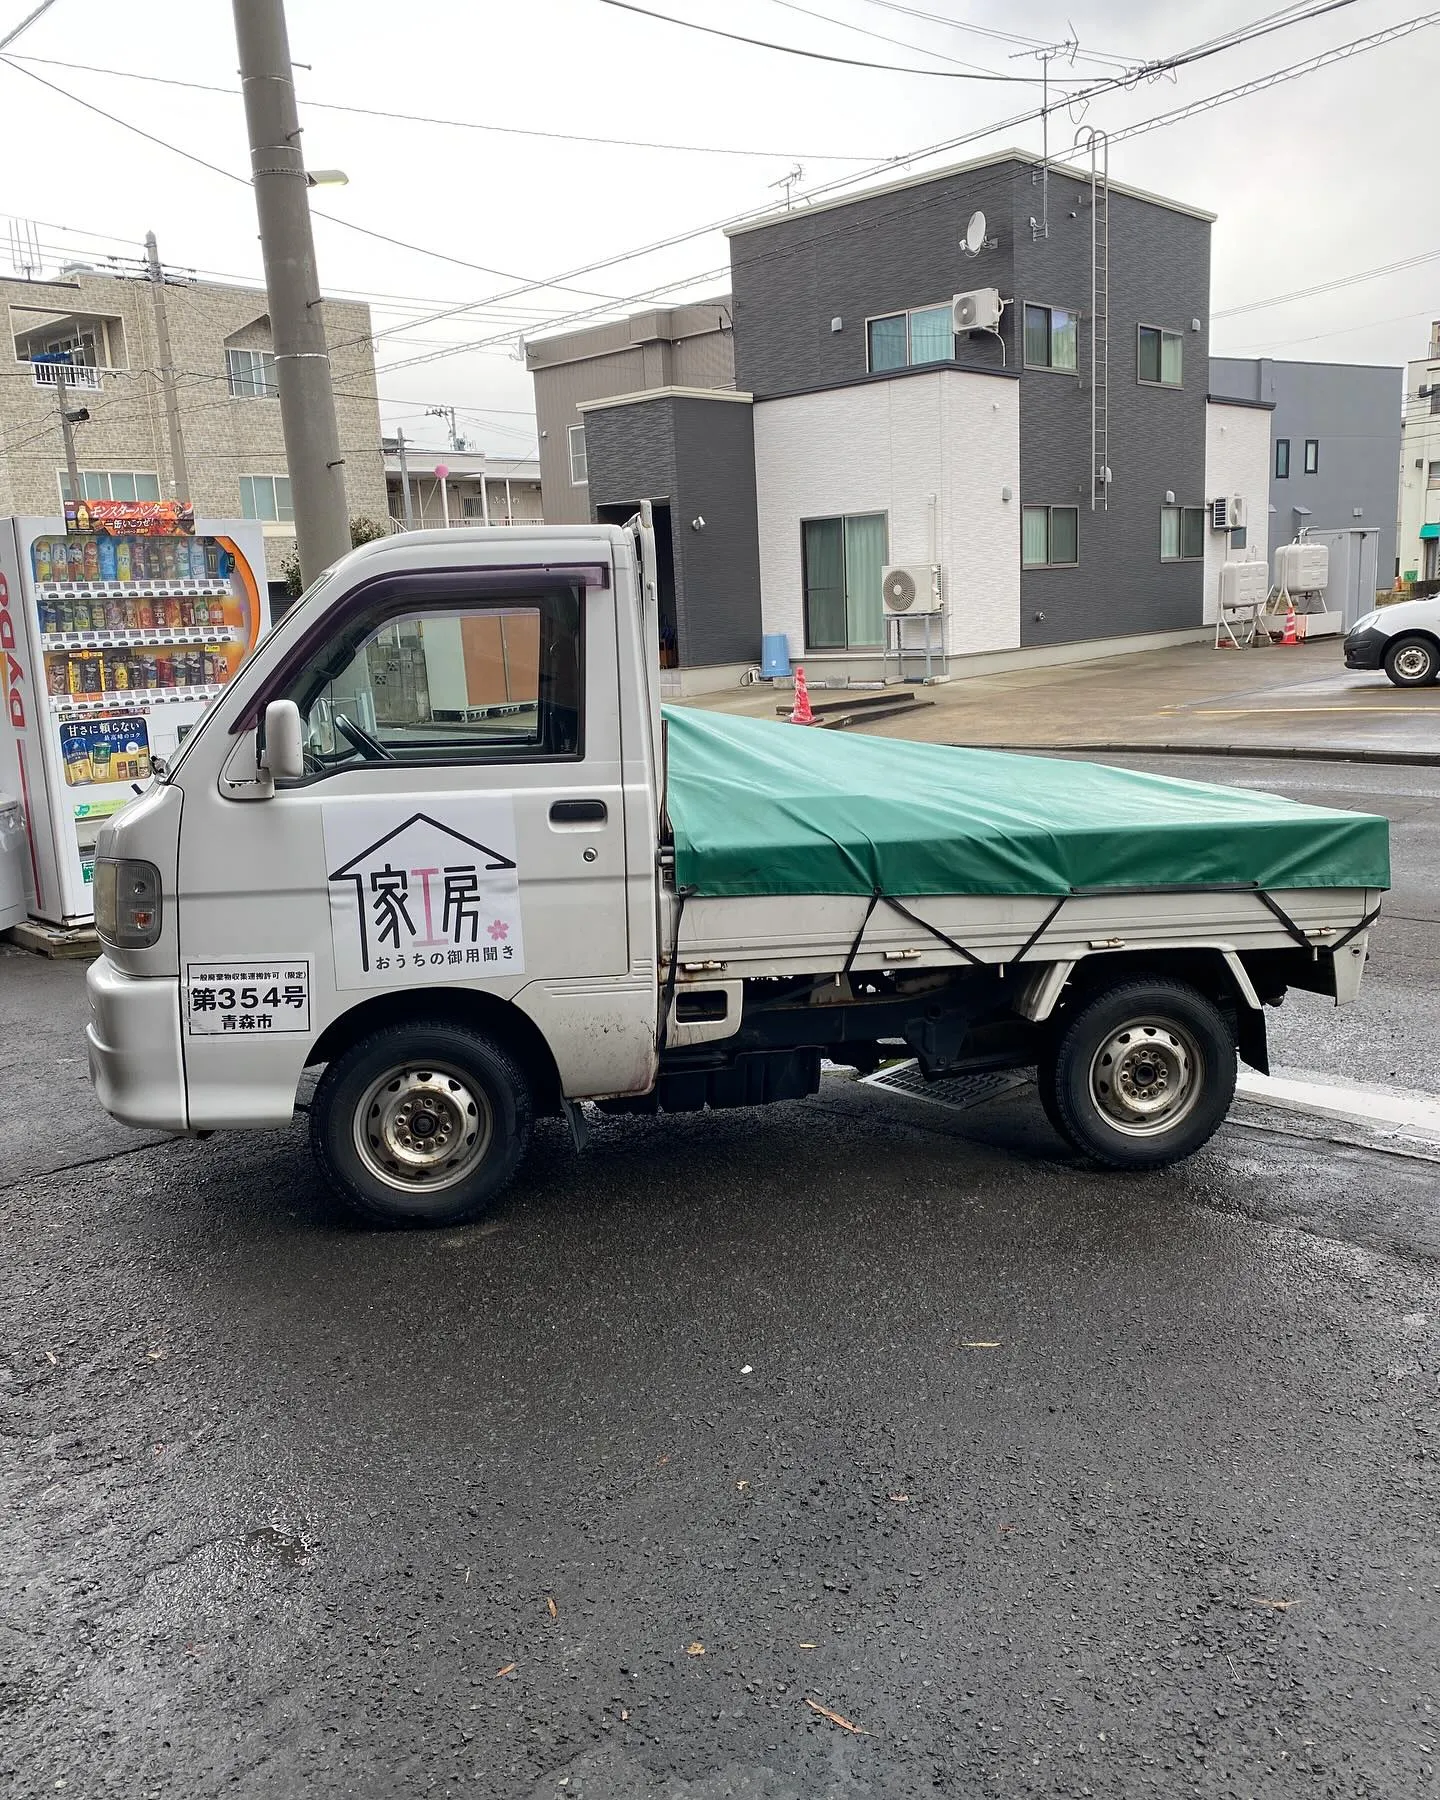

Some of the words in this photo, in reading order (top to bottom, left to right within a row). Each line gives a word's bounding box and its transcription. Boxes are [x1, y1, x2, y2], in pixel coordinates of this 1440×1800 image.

[90, 504, 168, 518] モンスターハンター
[67, 721, 140, 737] 甘さに頼らない
[370, 864, 481, 949] 家工房
[376, 945, 515, 970] おうちの御用聞き
[190, 985, 307, 1012] 第354号
[221, 1014, 273, 1030] 青森市
